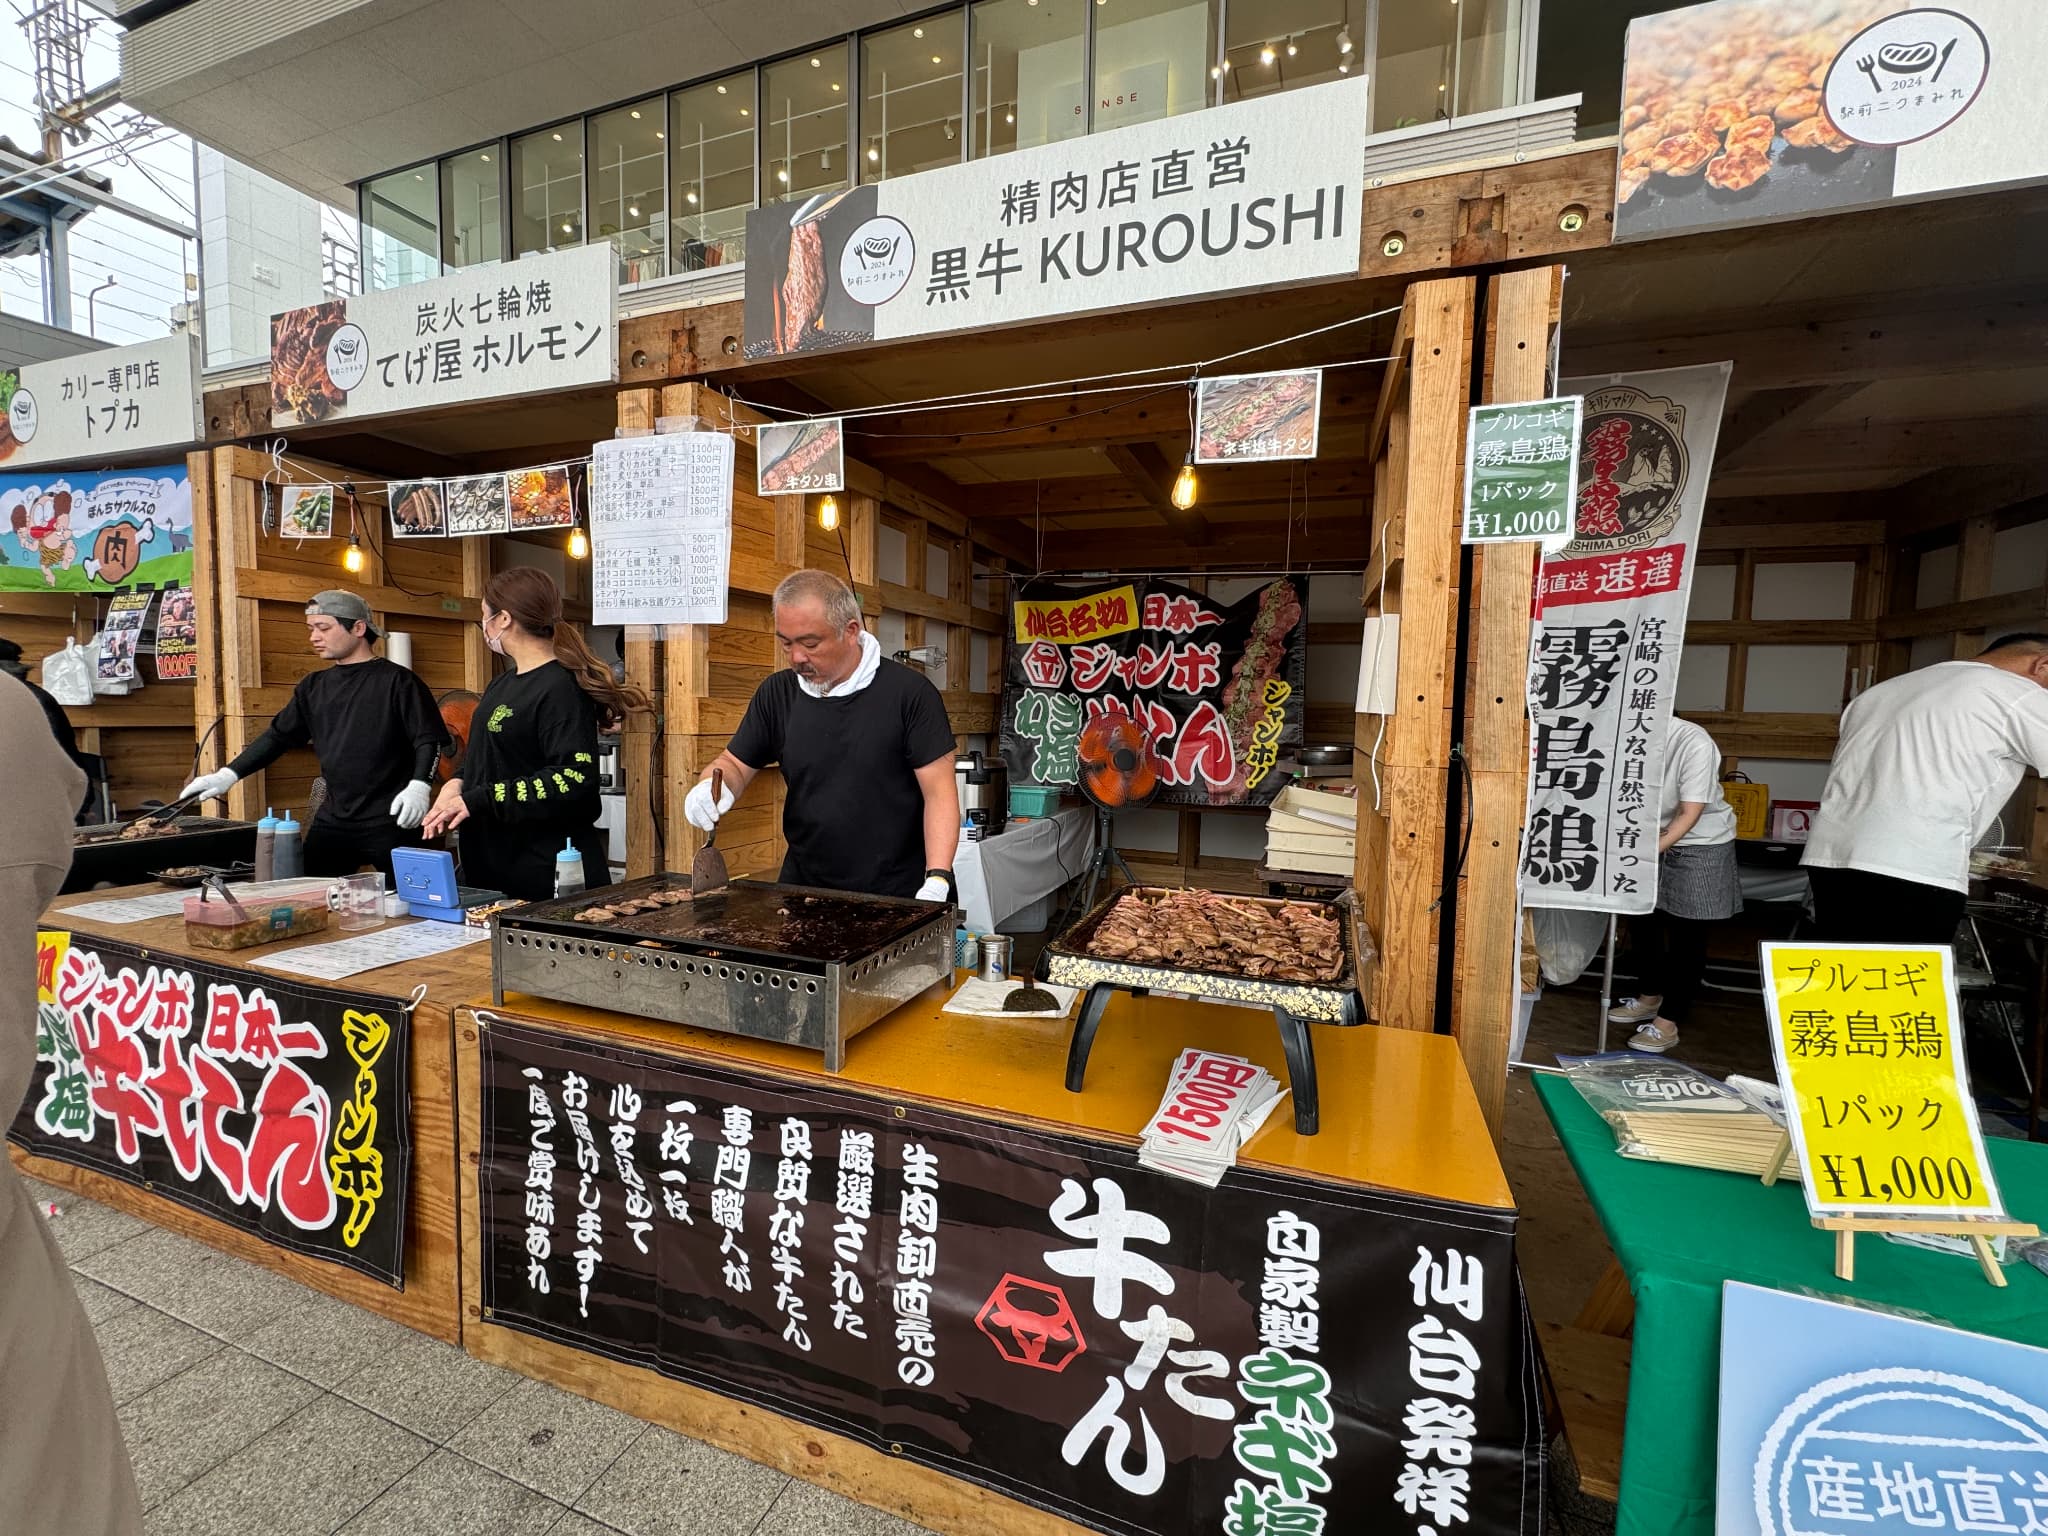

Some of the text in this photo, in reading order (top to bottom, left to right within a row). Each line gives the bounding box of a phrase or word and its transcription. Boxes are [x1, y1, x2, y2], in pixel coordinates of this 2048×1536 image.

[1074, 92, 1137, 115] SNSE
[1891, 76, 1922, 91] 2024
[1000, 135, 1252, 227] 精肉店直営
[925, 184, 1344, 306] 黒牛 KUROUSHI
[415, 280, 552, 337] 炭火七輪焼
[376, 320, 602, 388] てげ屋 ホルモン
[61, 360, 160, 401] カリー専門店
[86, 399, 140, 438] トプカ
[1483, 407, 1568, 434] プルコギ
[690, 443, 721, 453] 1100円
[690, 455, 721, 464] 1300円
[1222, 438, 1312, 457] ネギ塩牛タン
[1475, 434, 1569, 467] 霧島鶏
[690, 496, 719, 506] 1500円
[786, 472, 836, 489] 牛タン串
[1481, 481, 1558, 502] 1パック
[692, 535, 716, 544] 500円
[1475, 510, 1561, 535] ¥1,000
[1566, 533, 1650, 552] ISHIMA DORI
[104, 530, 129, 570] 肉
[692, 545, 716, 554] 600円
[1594, 551, 1674, 595] 速達
[1023, 593, 1226, 638] 仙台名物 日本一
[1069, 639, 1221, 695] ジャンボ
[1526, 618, 1630, 892] 霧島鶏
[1614, 617, 1667, 893] 宮崎の雄大な自然で育った
[1787, 958, 1929, 997] プルコギ
[57, 947, 196, 1033] ジャンボ
[206, 983, 328, 1068] 日本一
[1788, 1008, 1944, 1060] 霧島鶏
[71, 1007, 337, 1231] 牛たん
[1156, 1059, 1258, 1142] 1500円
[1815, 1094, 1943, 1132] 1パック
[520, 1066, 557, 1295] 一度ご賞味あれ
[608, 1083, 654, 1255] 心を込めて
[659, 1100, 697, 1226] 一枚一枚
[1819, 1155, 1973, 1203] ¥1,000
[711, 1104, 753, 1294] 専門職人が
[769, 1117, 813, 1353] 良質な牛たん
[830, 1129, 875, 1341] 厳選された
[893, 1143, 939, 1387] 生肉卸直売の
[1042, 1177, 1236, 1496] 牛たん
[1392, 1245, 1485, 1536] 仙台発祥
